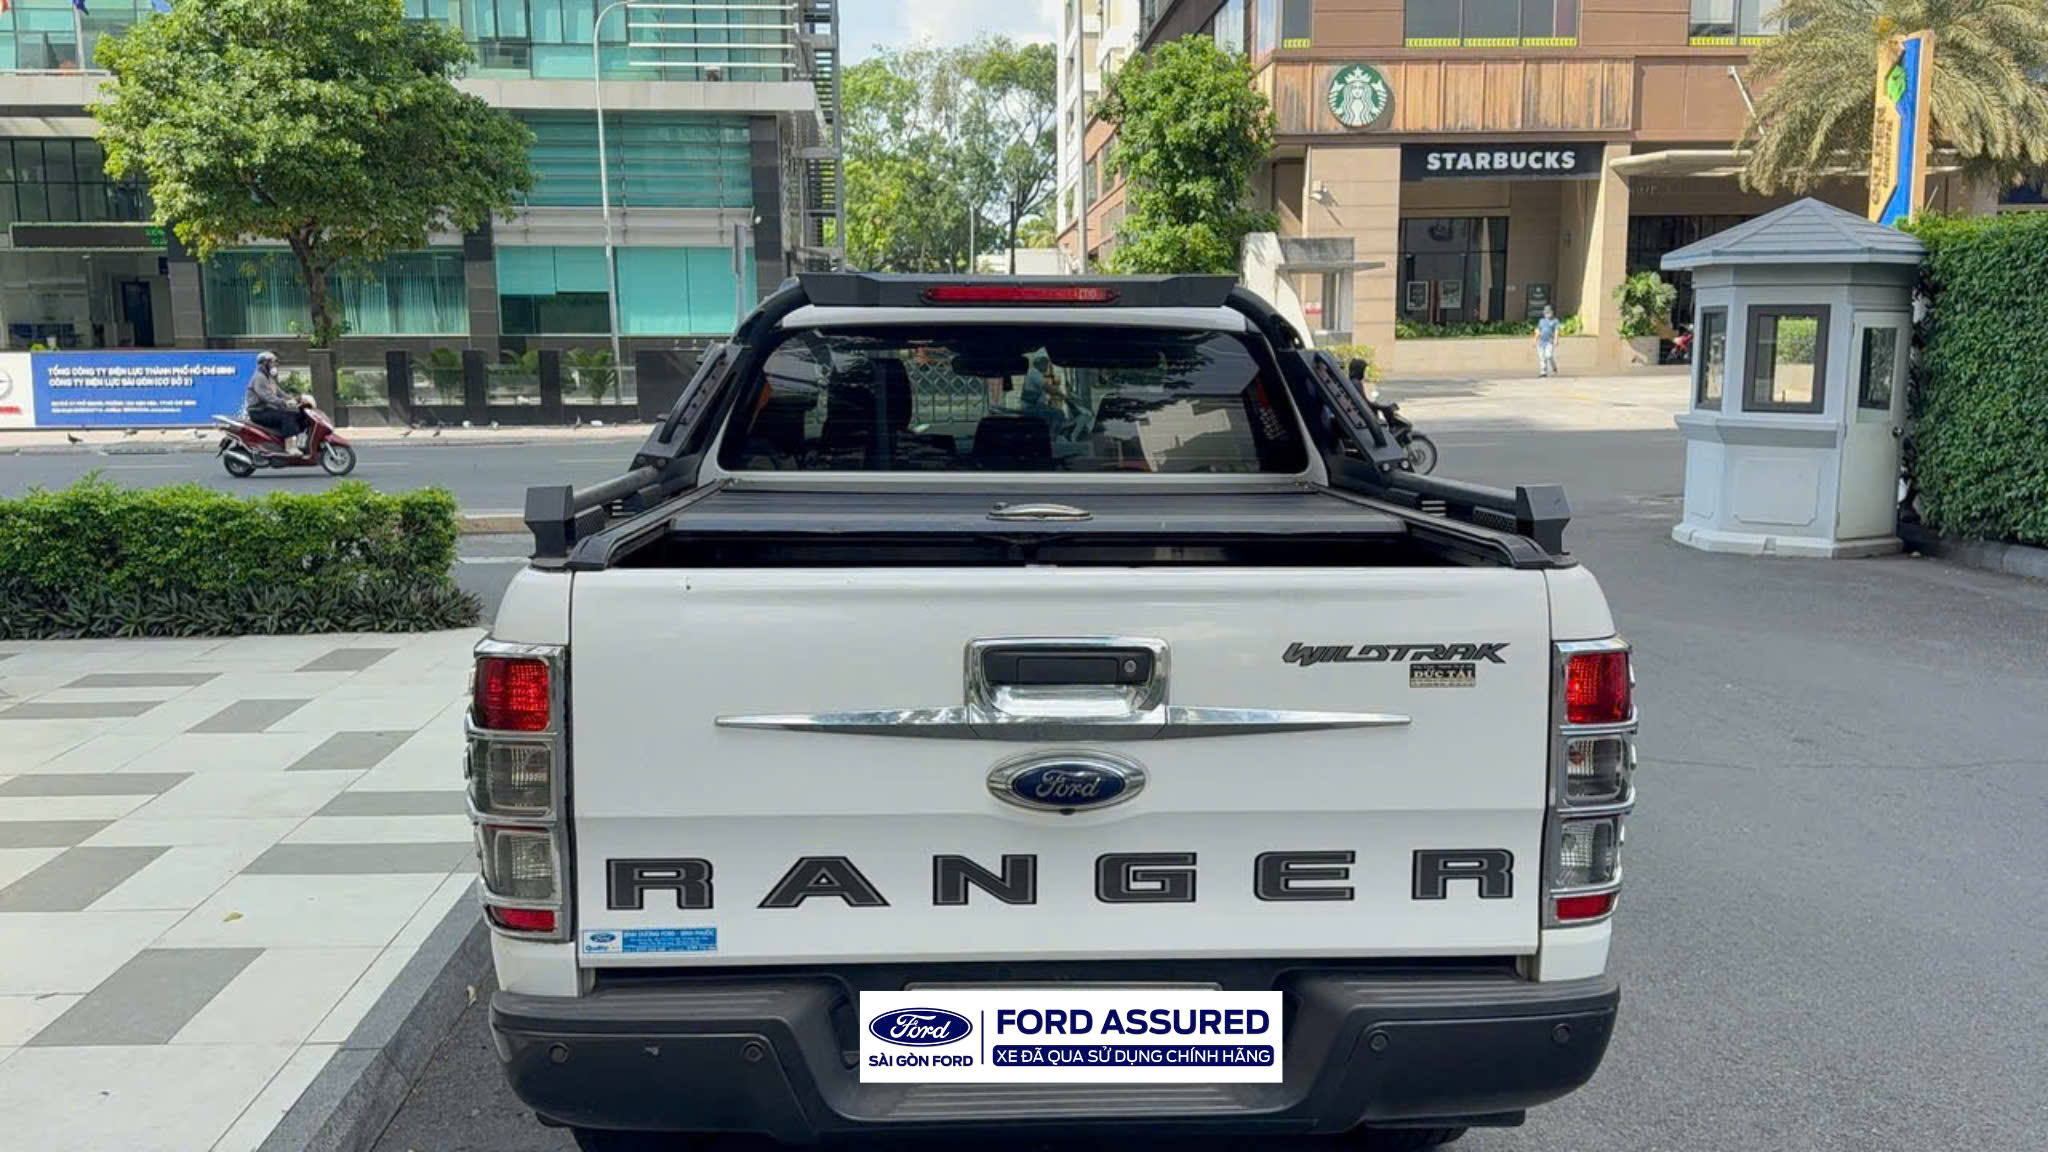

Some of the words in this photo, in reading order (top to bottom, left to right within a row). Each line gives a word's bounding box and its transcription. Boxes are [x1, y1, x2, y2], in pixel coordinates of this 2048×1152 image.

[1427, 151, 1576, 170] STARBUCKS
[72, 365, 95, 376] CÔNG
[97, 366, 108, 376] TY
[48, 377, 73, 387] CÔNG
[74, 378, 85, 387] TY
[1282, 642, 1510, 667] WILDTRAK
[1035, 769, 1101, 798] Ford
[606, 849, 1514, 911] RANGER
